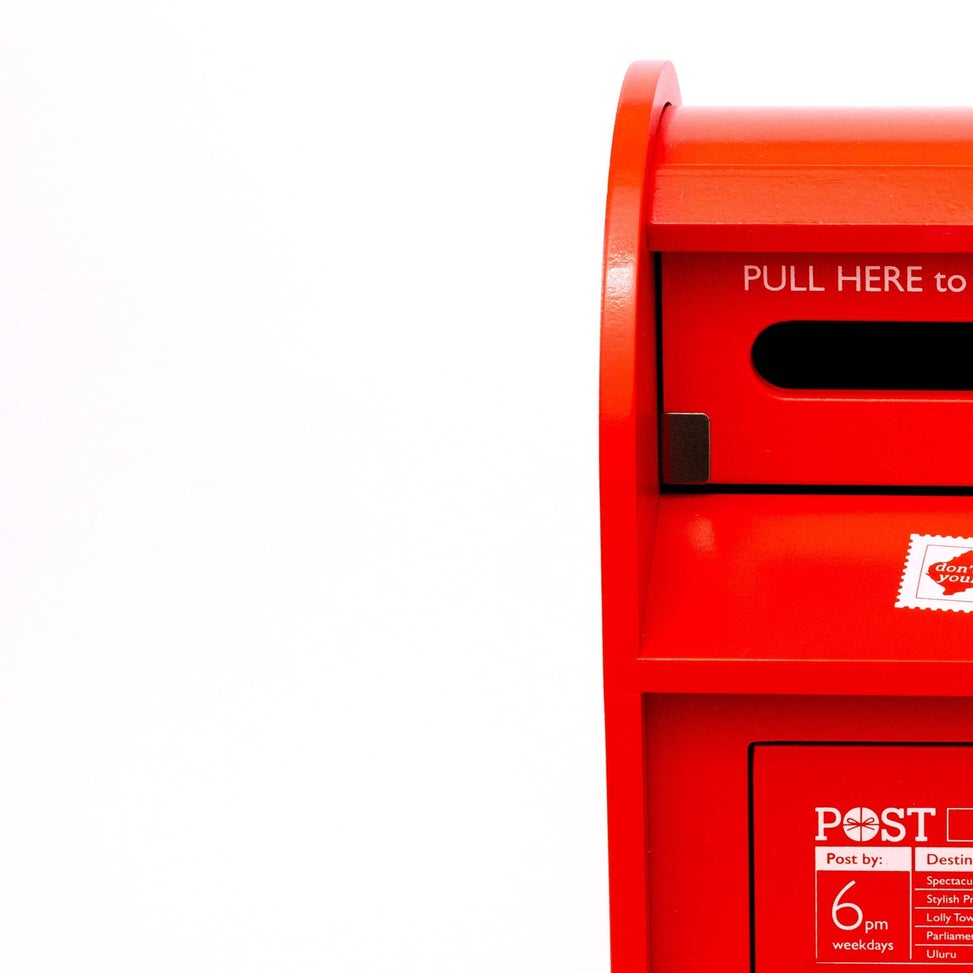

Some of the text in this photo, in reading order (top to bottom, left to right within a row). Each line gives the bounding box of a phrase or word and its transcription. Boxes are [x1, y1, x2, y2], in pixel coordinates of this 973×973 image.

[744, 266, 825, 292] PULL
[838, 266, 923, 292] HERE
[935, 272, 966, 293] to
[815, 807, 936, 842] POST
[827, 852, 882, 869] Post by:
[832, 880, 888, 934] 6 pm
[927, 895, 959, 906] Stylish
[927, 913, 951, 925] Lolly
[833, 939, 893, 953] weekdays
[927, 949, 957, 959] Uluru
